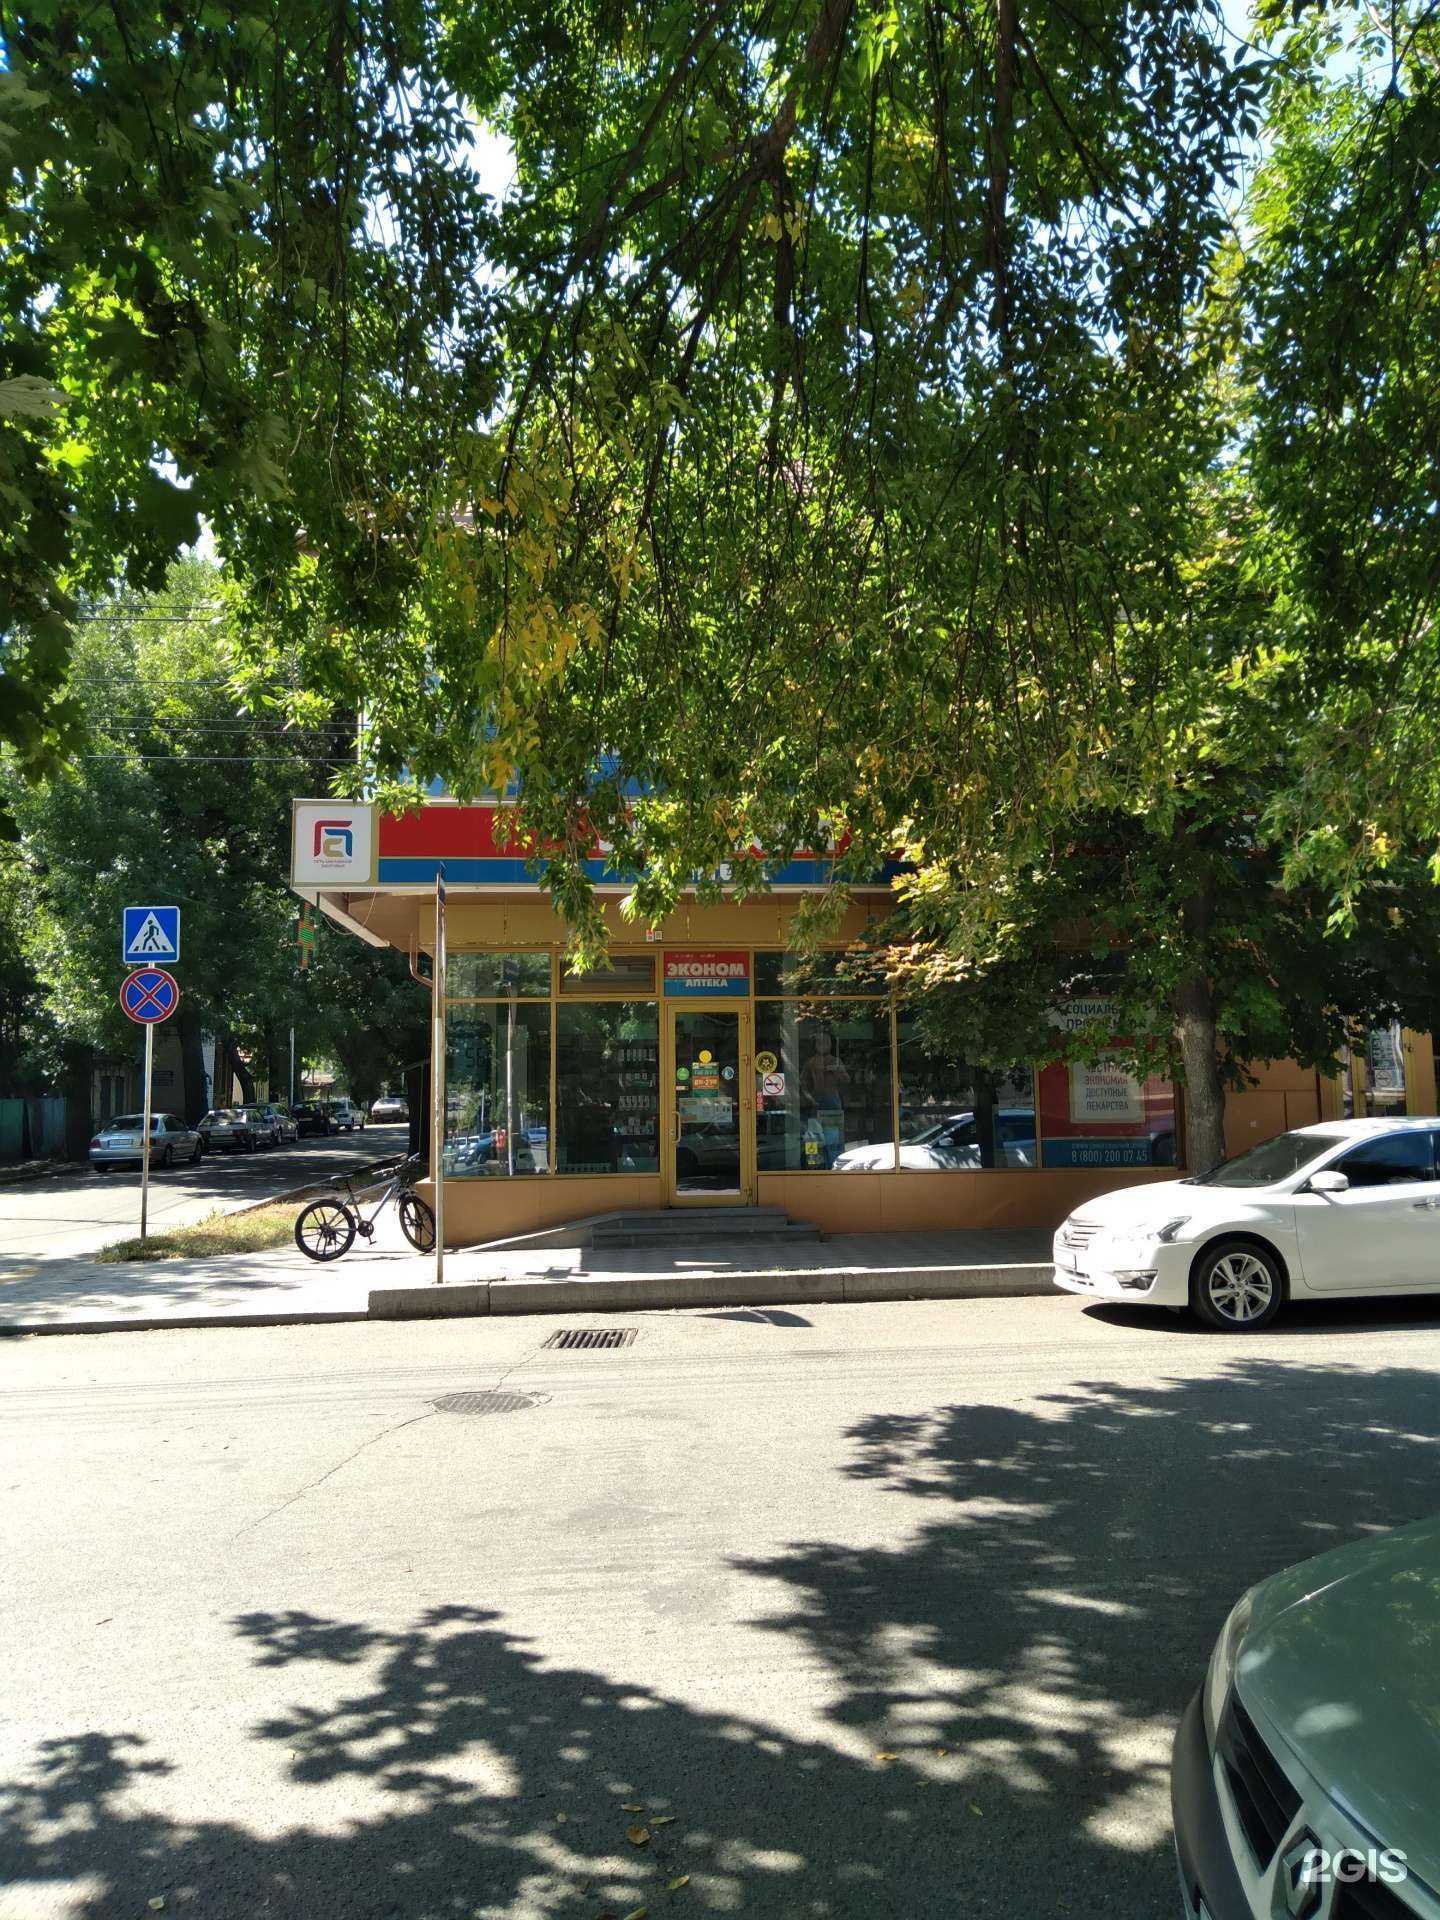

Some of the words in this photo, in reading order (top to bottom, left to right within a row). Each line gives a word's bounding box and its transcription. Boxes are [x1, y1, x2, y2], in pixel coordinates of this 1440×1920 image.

[667, 962, 745, 977] ЭКОНОМ
[685, 978, 729, 988] АПТЕКА
[1066, 1003, 1121, 1016] СОЦИАЛЬ
[1085, 1075, 1128, 1085] ЭКОНОМИЯ
[1085, 1087, 1128, 1098] ДОСТУПНЫЕ
[1086, 1101, 1129, 1111] ЛЕКАРСТВА
[1104, 1150, 1121, 1162] 200
